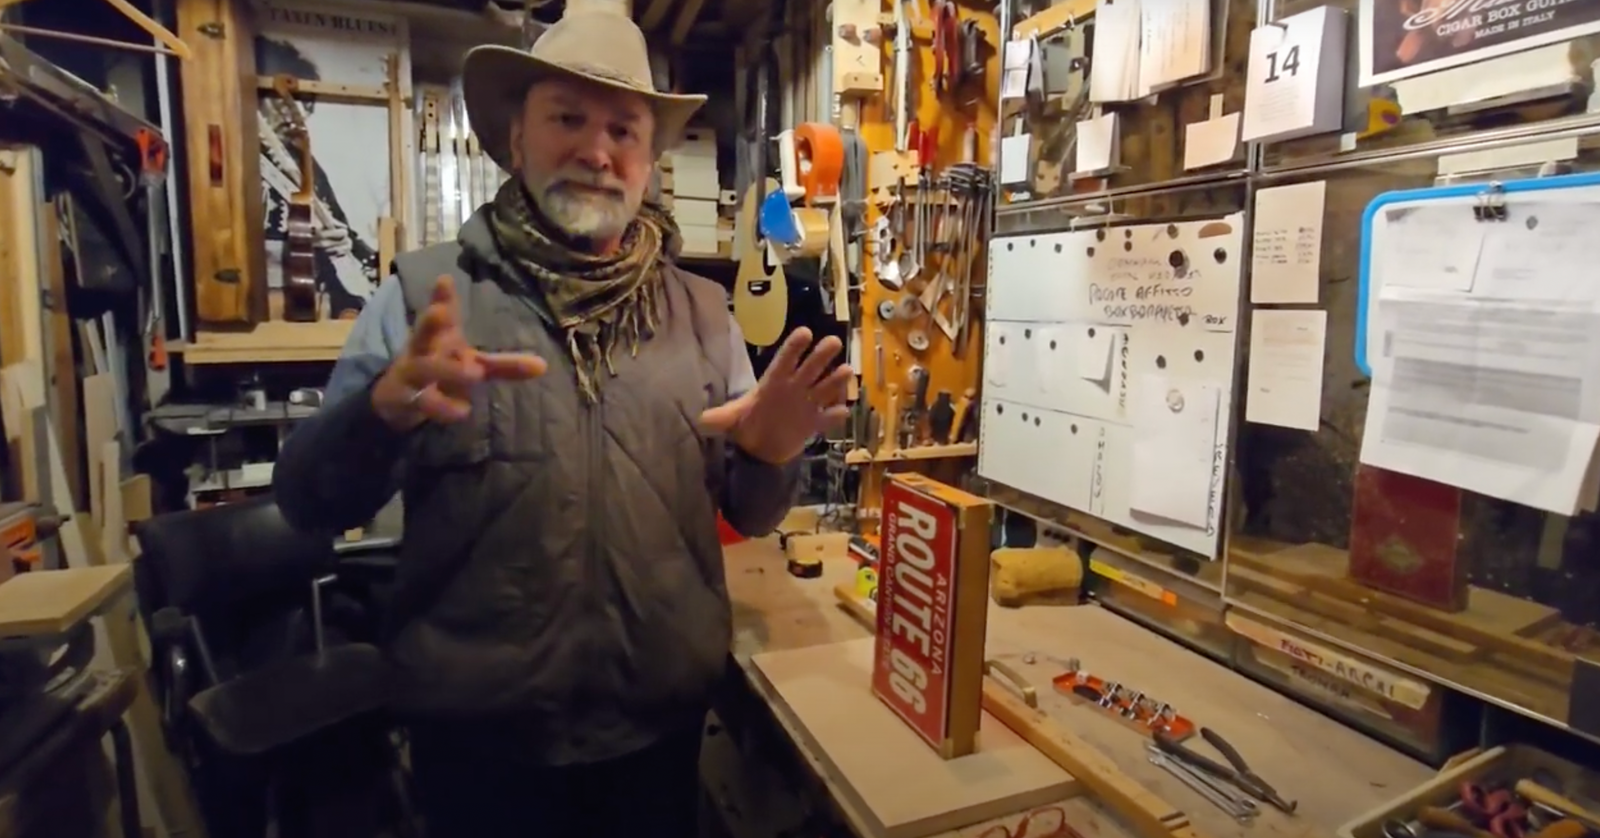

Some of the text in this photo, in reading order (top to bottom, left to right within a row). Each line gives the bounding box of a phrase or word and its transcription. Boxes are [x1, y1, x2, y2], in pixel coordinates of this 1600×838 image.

[1436, 15, 1482, 37] CIGAR
[1487, 3, 1521, 23] BOX
[1475, 10, 1556, 39] MADE IN ITALY
[1263, 44, 1301, 84] 14
[886, 511, 897, 565] GRAND
[889, 501, 938, 716] ROUTE 66
[931, 572, 948, 676] ARIZONA
